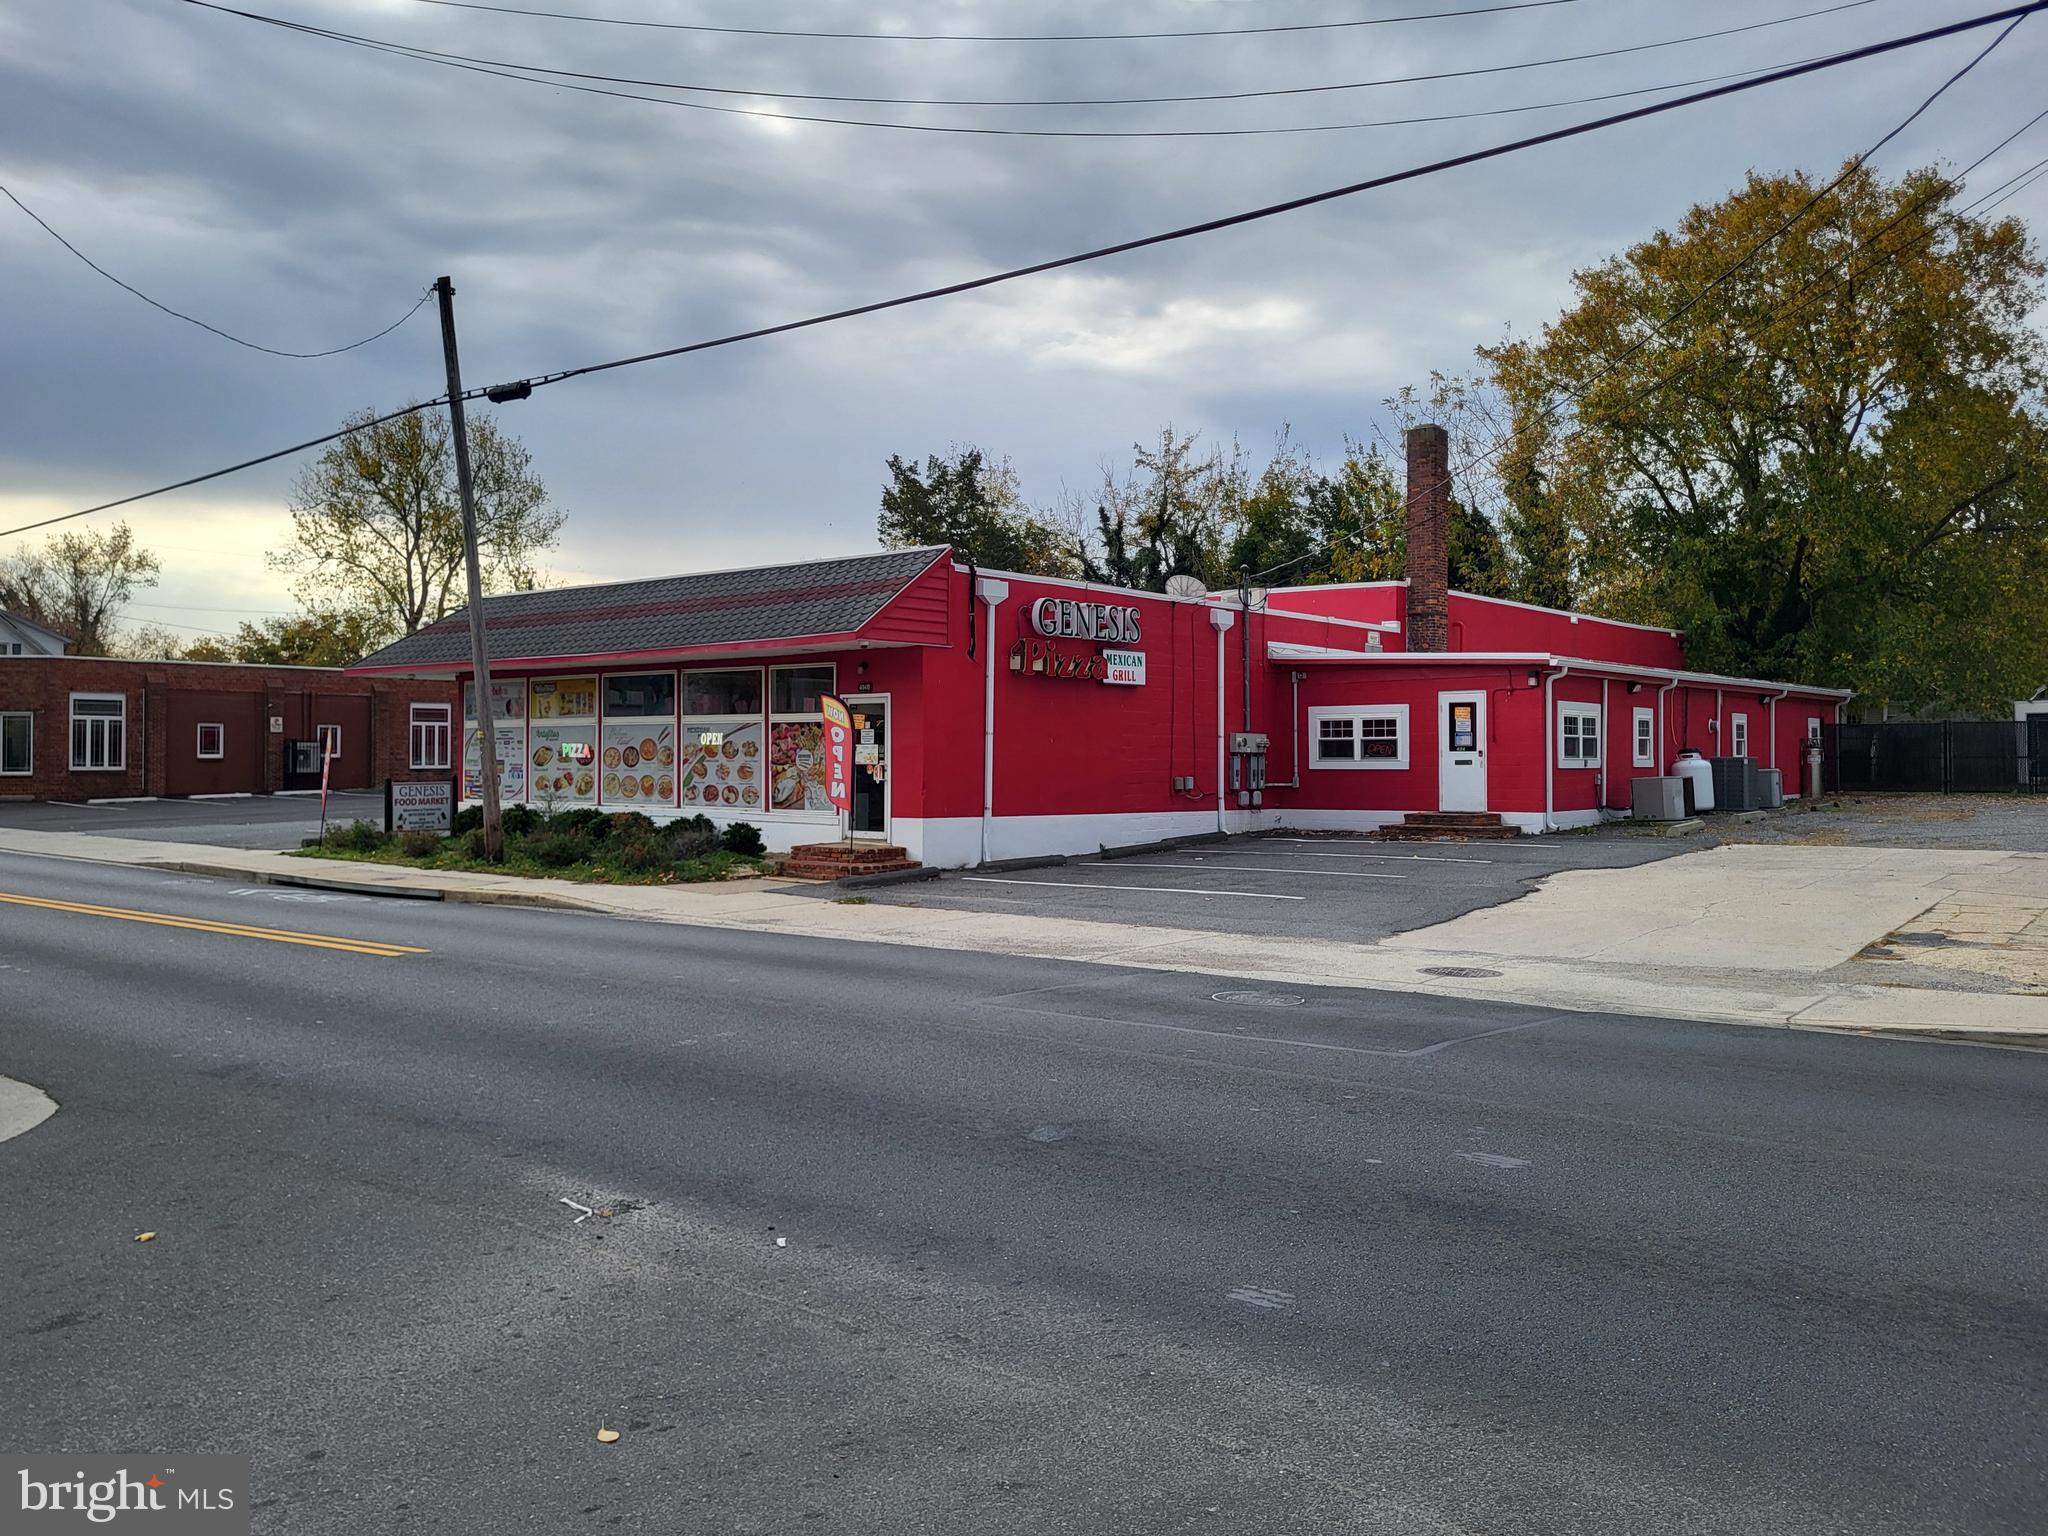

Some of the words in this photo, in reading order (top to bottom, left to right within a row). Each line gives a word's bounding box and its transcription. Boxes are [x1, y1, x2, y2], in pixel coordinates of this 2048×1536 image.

[1032, 597, 1141, 643] GENESIS
[1011, 638, 1109, 680] Pizza
[1106, 653, 1143, 667] MEXICAN
[1112, 670, 1136, 682] GRILL
[700, 732, 724, 746] OPEN
[562, 743, 591, 758] PIZZA
[1367, 743, 1393, 755] OPEN
[399, 785, 446, 798] GENESIS
[394, 798, 417, 807] FOOD
[418, 797, 449, 806] MARKET
